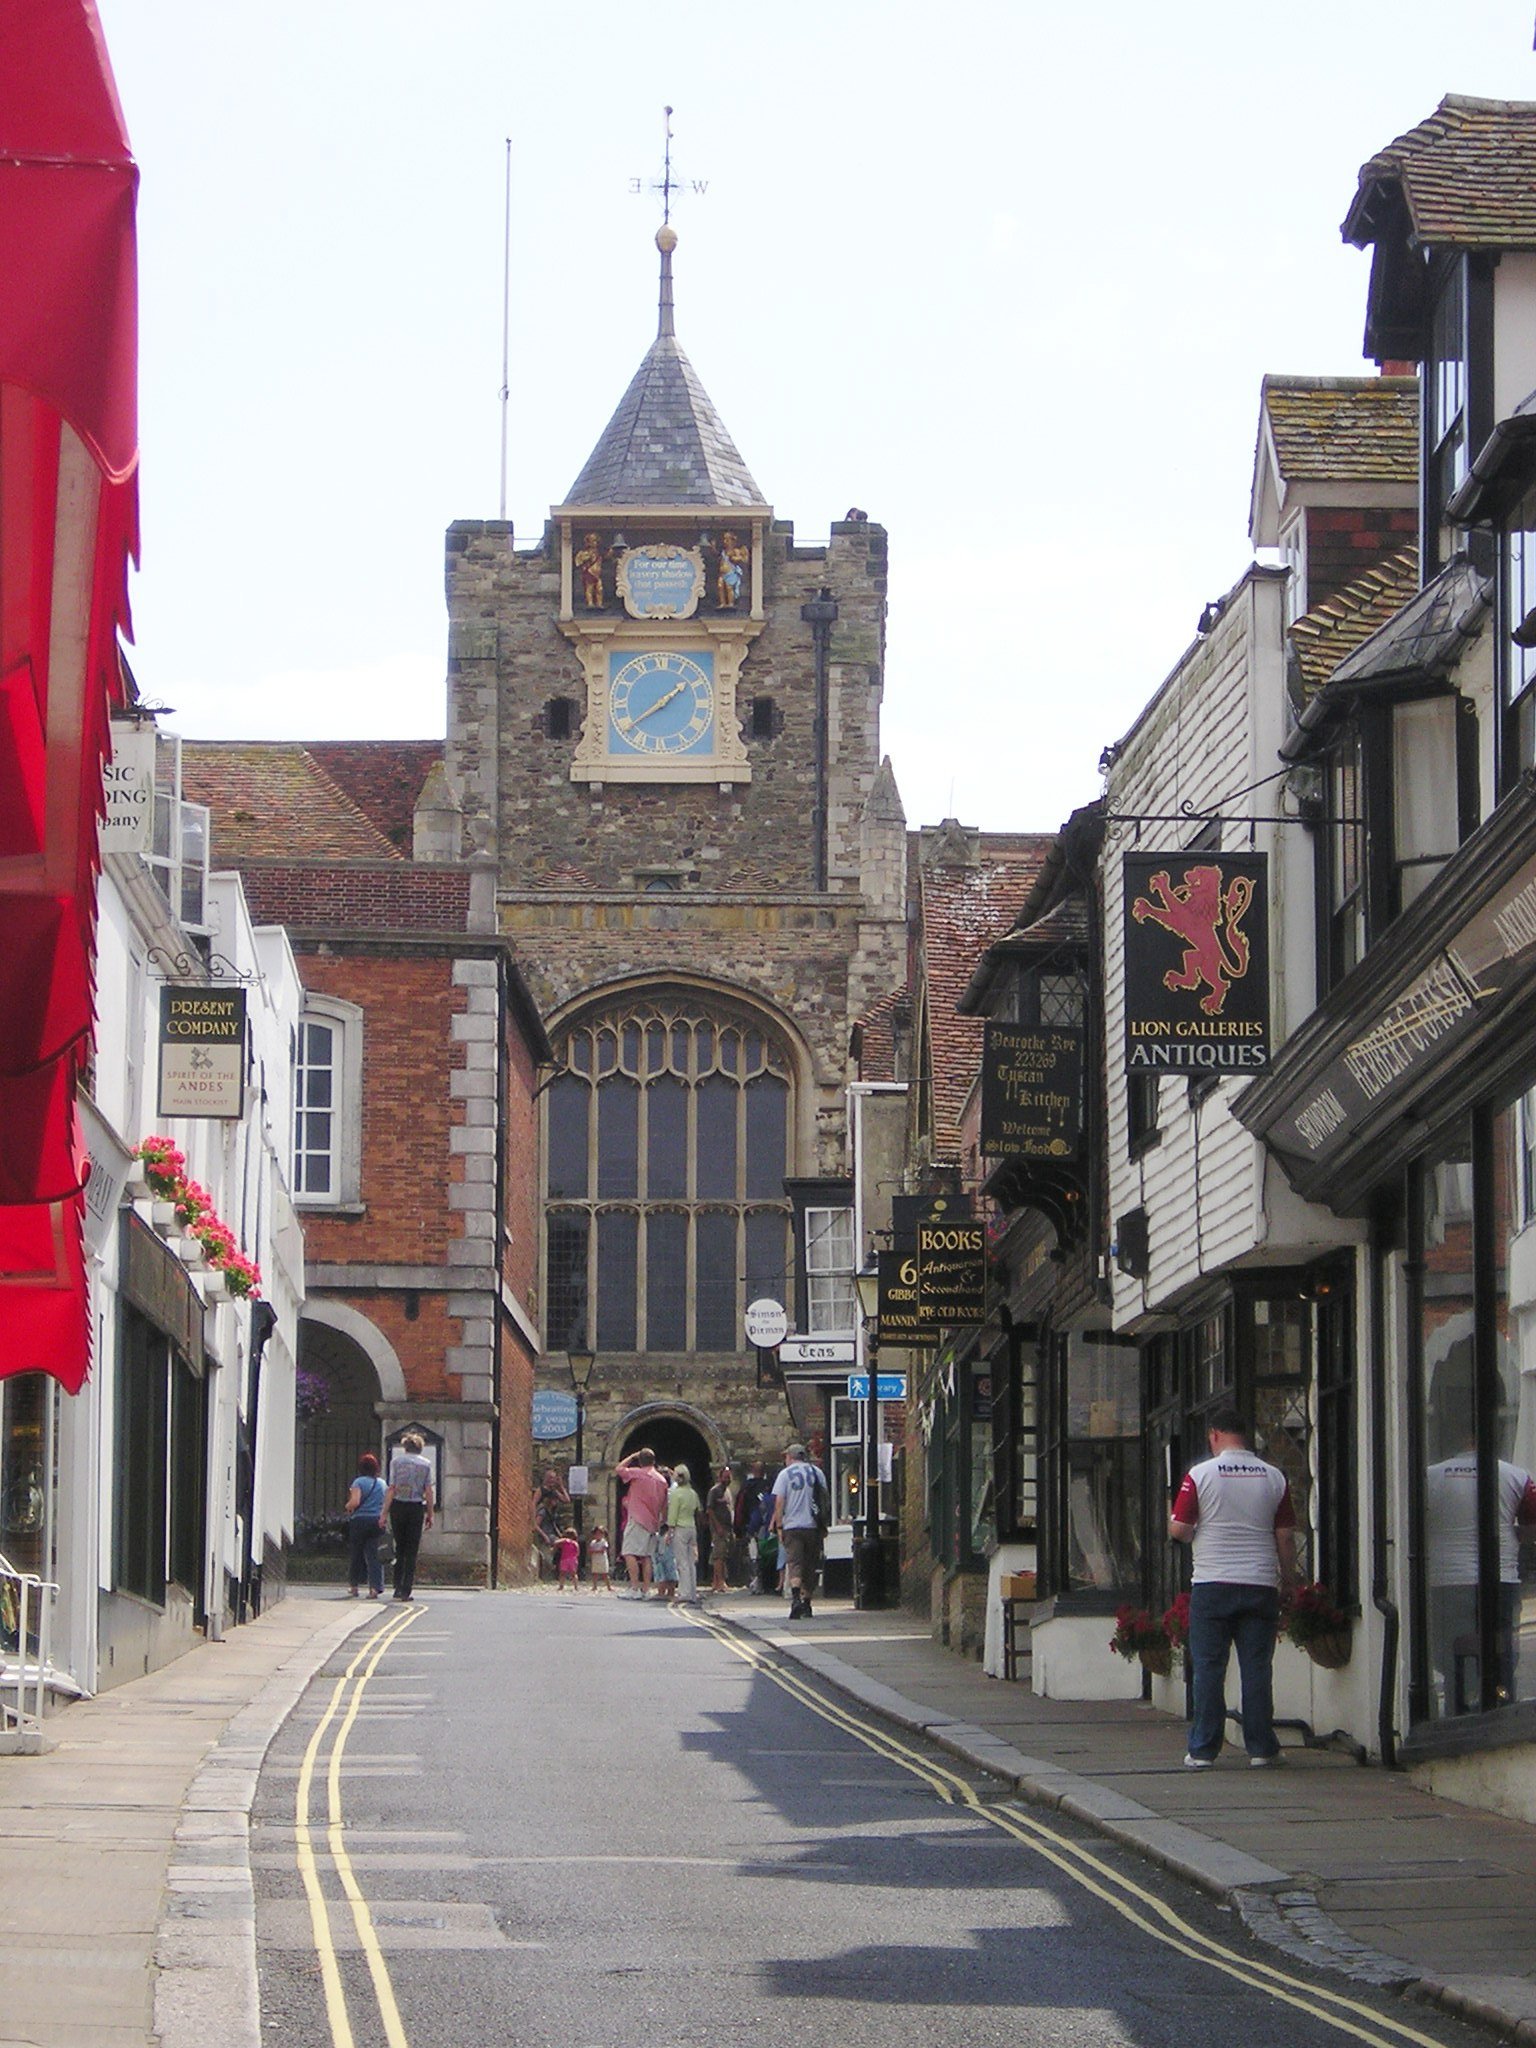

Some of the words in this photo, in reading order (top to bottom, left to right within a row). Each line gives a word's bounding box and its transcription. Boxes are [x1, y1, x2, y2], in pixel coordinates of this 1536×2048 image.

[692, 180, 709, 195] W
[634, 560, 649, 569] For
[651, 561, 668, 569] our
[104, 767, 135, 781] SIC
[171, 1000, 234, 1015] PRESENT
[166, 1020, 239, 1035] COMPANY
[1131, 1021, 1171, 1036] LION
[1175, 1021, 1264, 1036] GALLERIES
[1130, 1044, 1267, 1068] ANTIQUES
[1343, 1016, 1414, 1101] HERBERT
[166, 1071, 196, 1079] SPIRIT
[200, 1071, 212, 1079] OF
[217, 1072, 235, 1080] THE
[997, 1064, 1044, 1083] Tuscan
[178, 1081, 224, 1091] ANDES
[1019, 1089, 1071, 1108] Kitchen
[1002, 1121, 1052, 1137] Welcome
[921, 1230, 983, 1250] BOOKS
[899, 1258, 917, 1285] 6
[750, 1308, 782, 1319] Simon
[880, 1314, 918, 1327] MANNIN
[918, 1306, 936, 1321] RYE
[937, 1306, 956, 1318] OLD
[798, 1344, 835, 1358] Teas
[1218, 1465, 1267, 1473] Hattons
